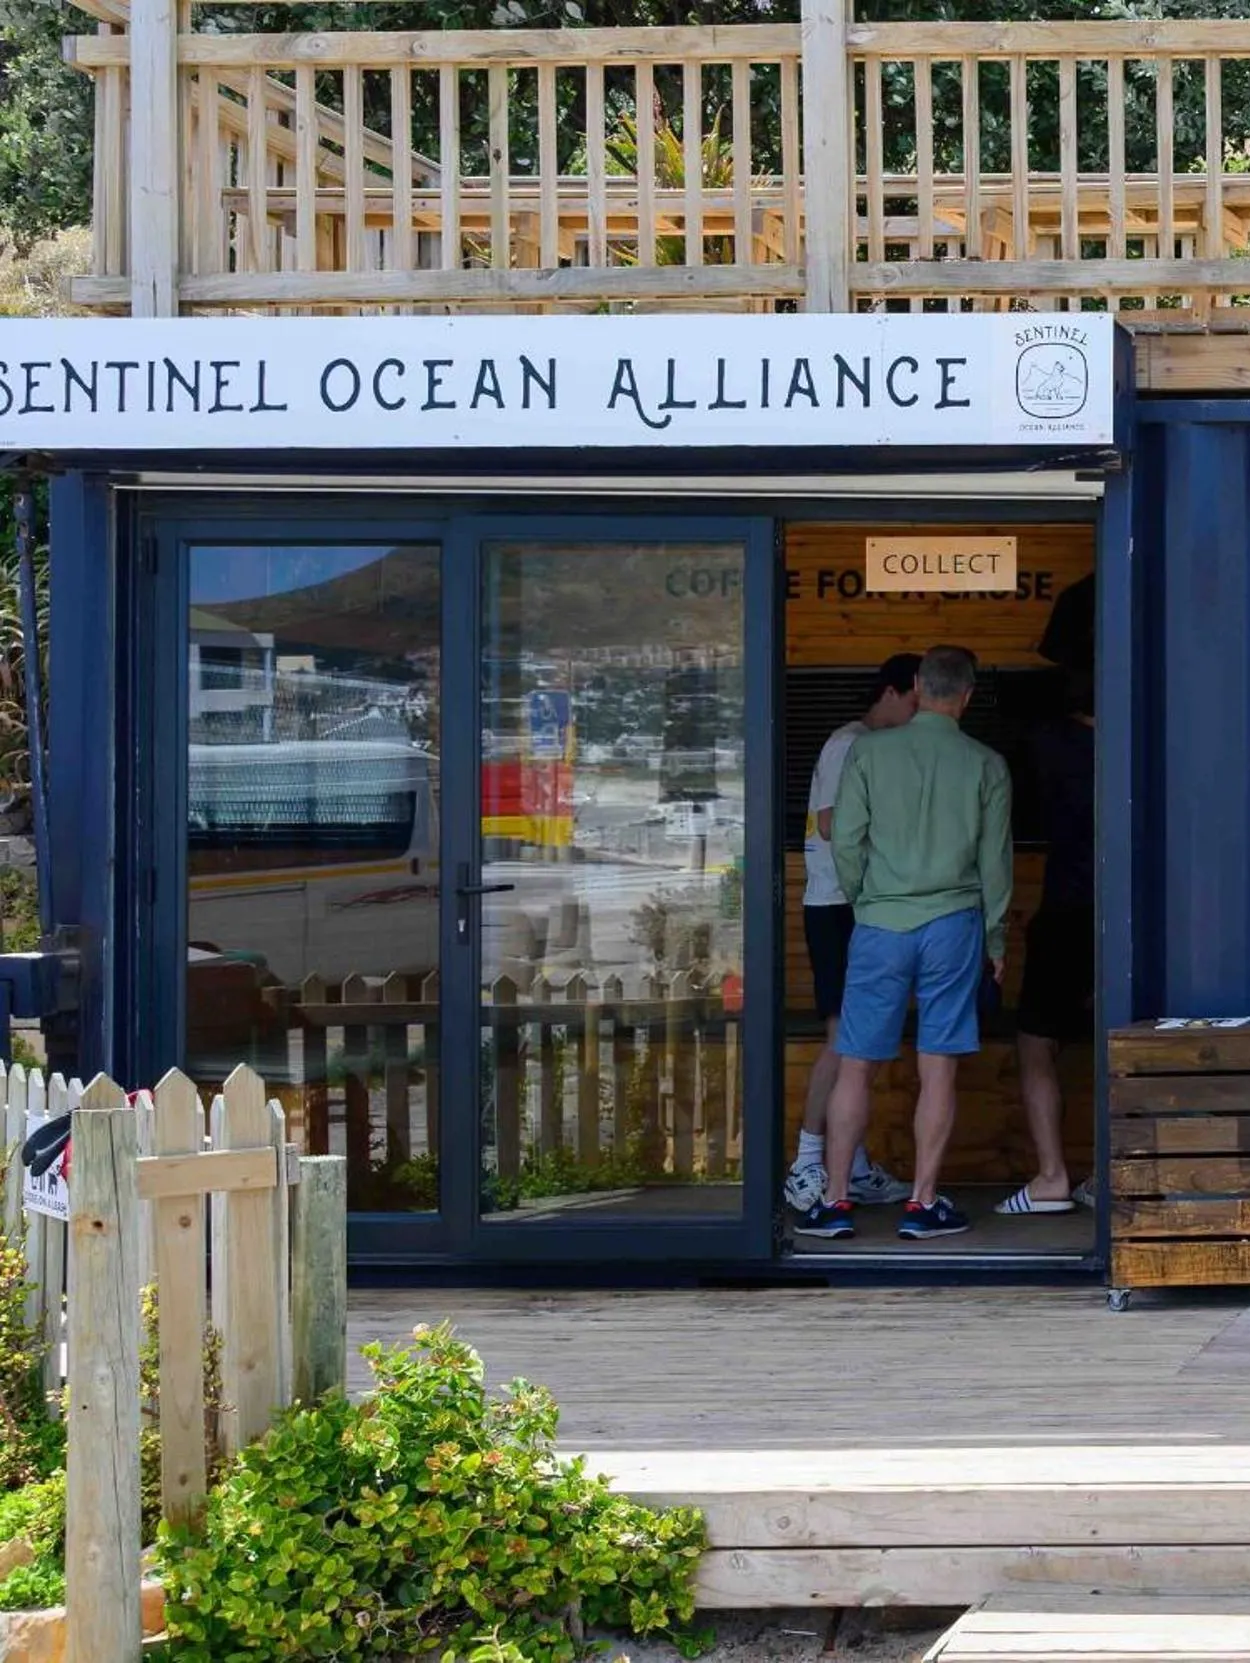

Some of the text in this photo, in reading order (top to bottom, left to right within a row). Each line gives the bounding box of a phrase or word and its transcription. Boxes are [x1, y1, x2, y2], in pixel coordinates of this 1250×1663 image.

[1015, 325, 1088, 347] SENTINEL
[319, 354, 557, 412] OCEAN
[606, 353, 971, 430] ALLIANCE
[882, 553, 1001, 574] COLLECT
[665, 568, 888, 599] COFE FO
